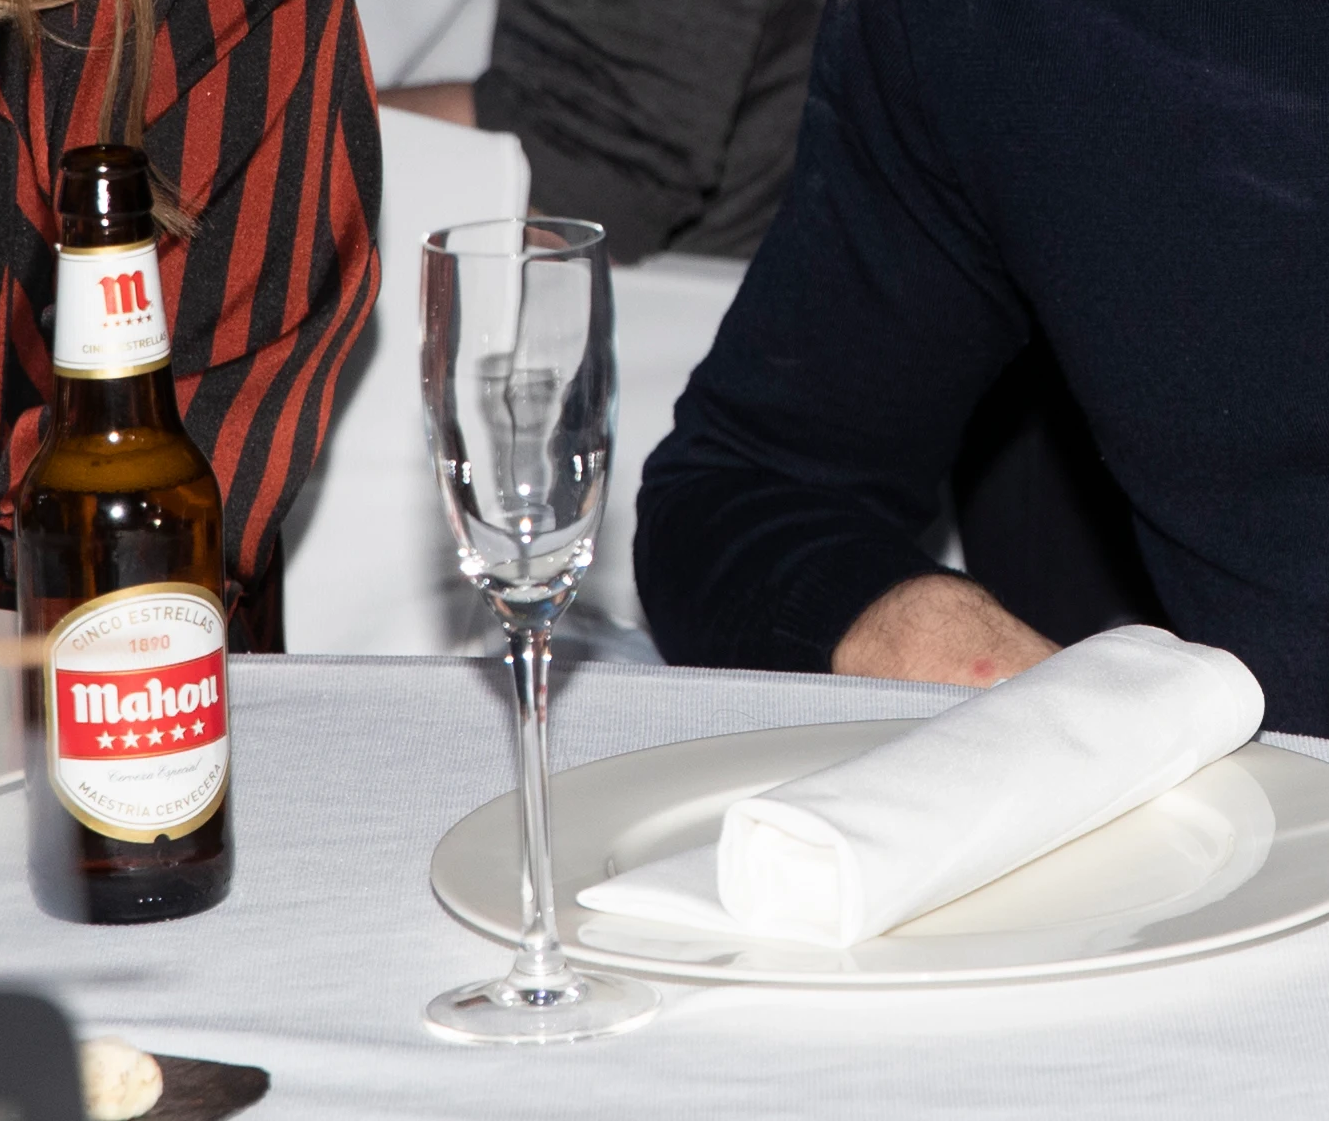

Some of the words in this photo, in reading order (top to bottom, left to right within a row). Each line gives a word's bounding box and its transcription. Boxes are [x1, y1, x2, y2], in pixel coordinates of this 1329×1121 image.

[72, 616, 122, 651] CINCO
[128, 606, 215, 634] ESTRELLAS
[129, 634, 171, 654] 1890
[71, 675, 219, 724] Mahou
[155, 764, 221, 817] CERVECERA
